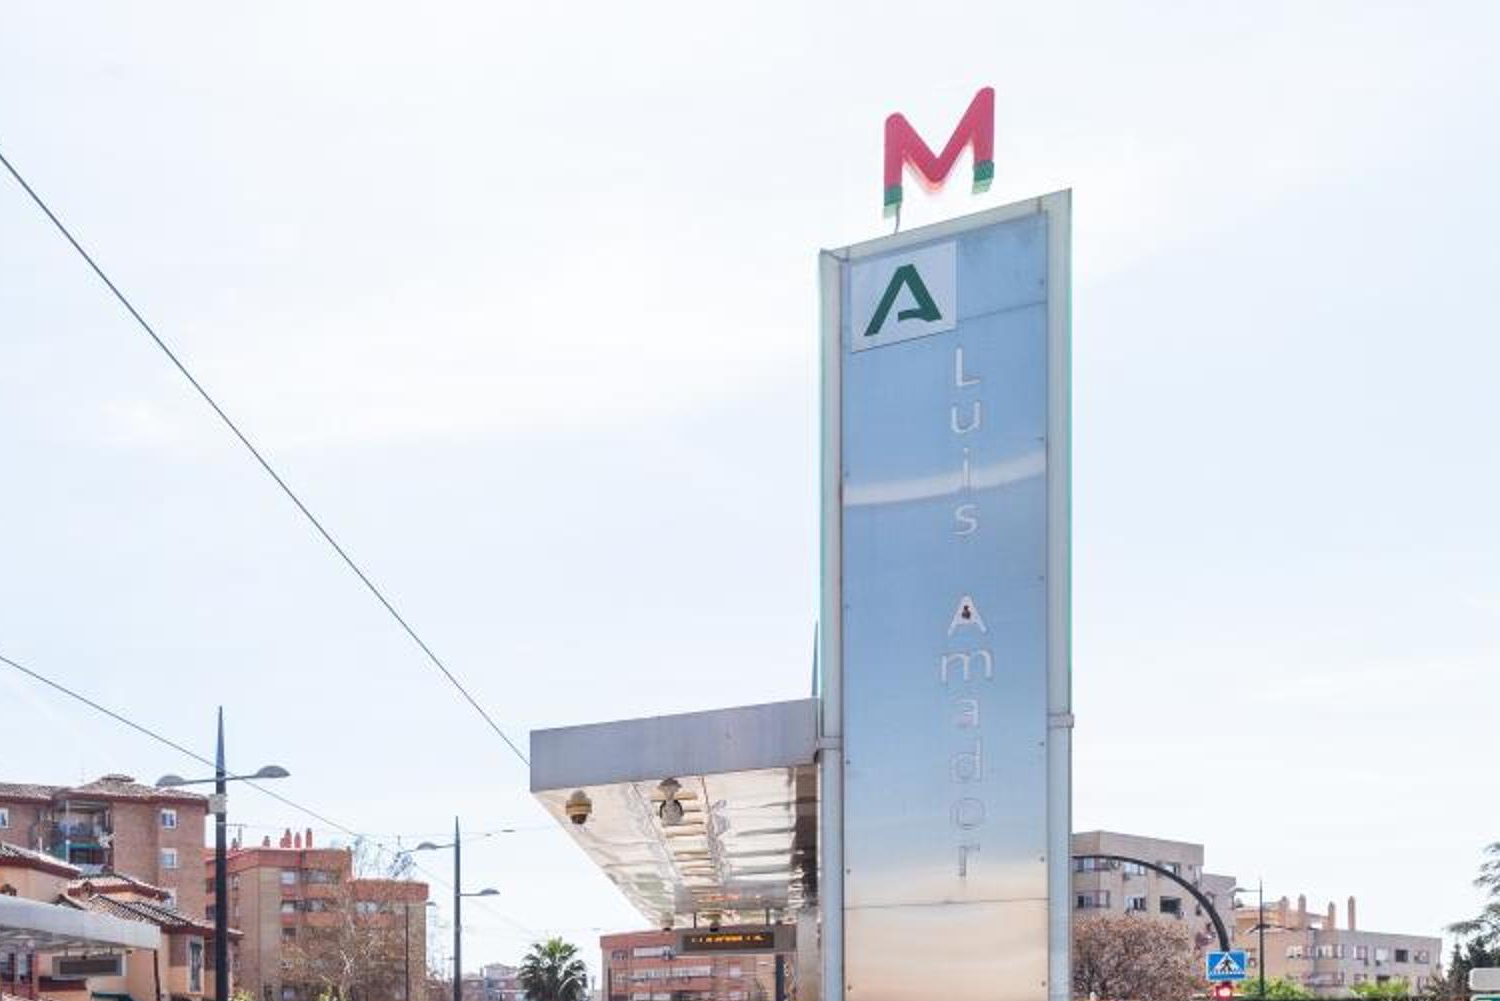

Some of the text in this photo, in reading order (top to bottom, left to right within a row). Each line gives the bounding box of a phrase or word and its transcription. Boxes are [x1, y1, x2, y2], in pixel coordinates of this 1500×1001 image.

[884, 86, 995, 214] M
[863, 263, 943, 337] A
[939, 347, 994, 877] Luis Amador
